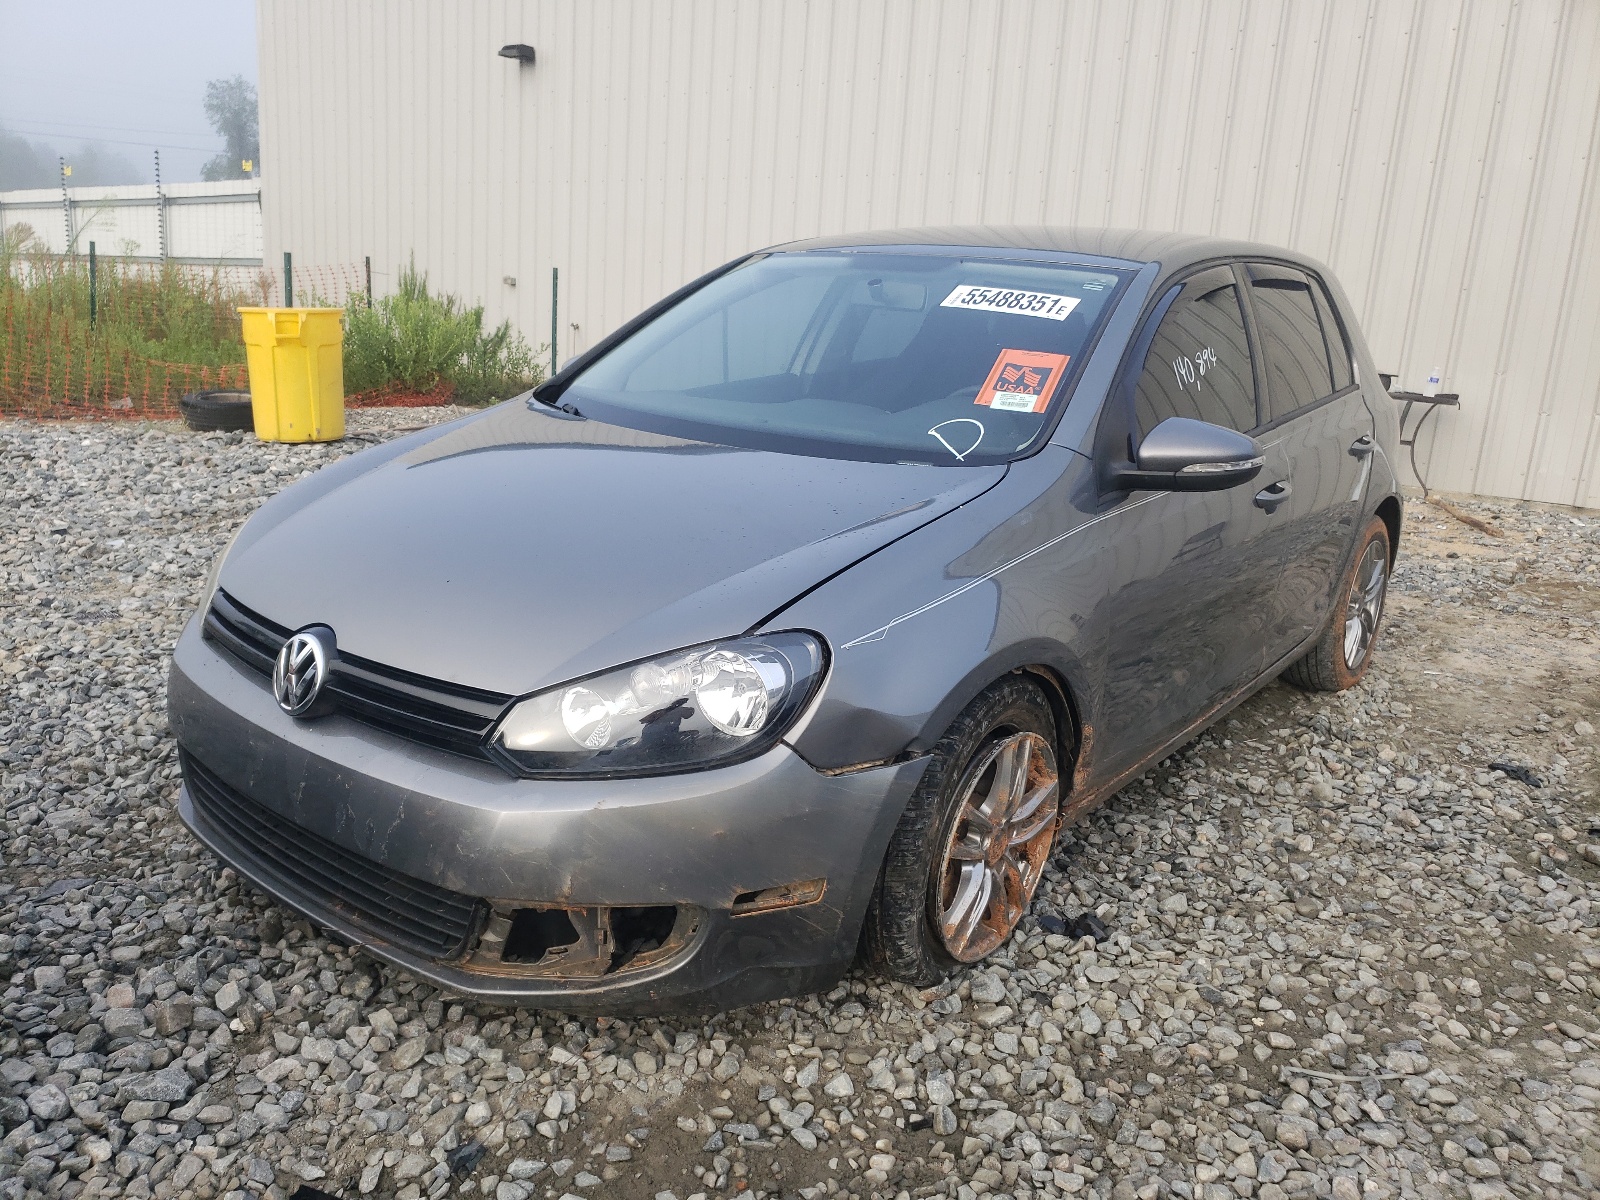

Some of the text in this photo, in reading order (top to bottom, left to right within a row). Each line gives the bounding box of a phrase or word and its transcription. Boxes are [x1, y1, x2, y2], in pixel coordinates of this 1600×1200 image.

[961, 288, 1062, 314] 55488351
[1055, 305, 1068, 316] E
[996, 381, 1035, 395] USAA
